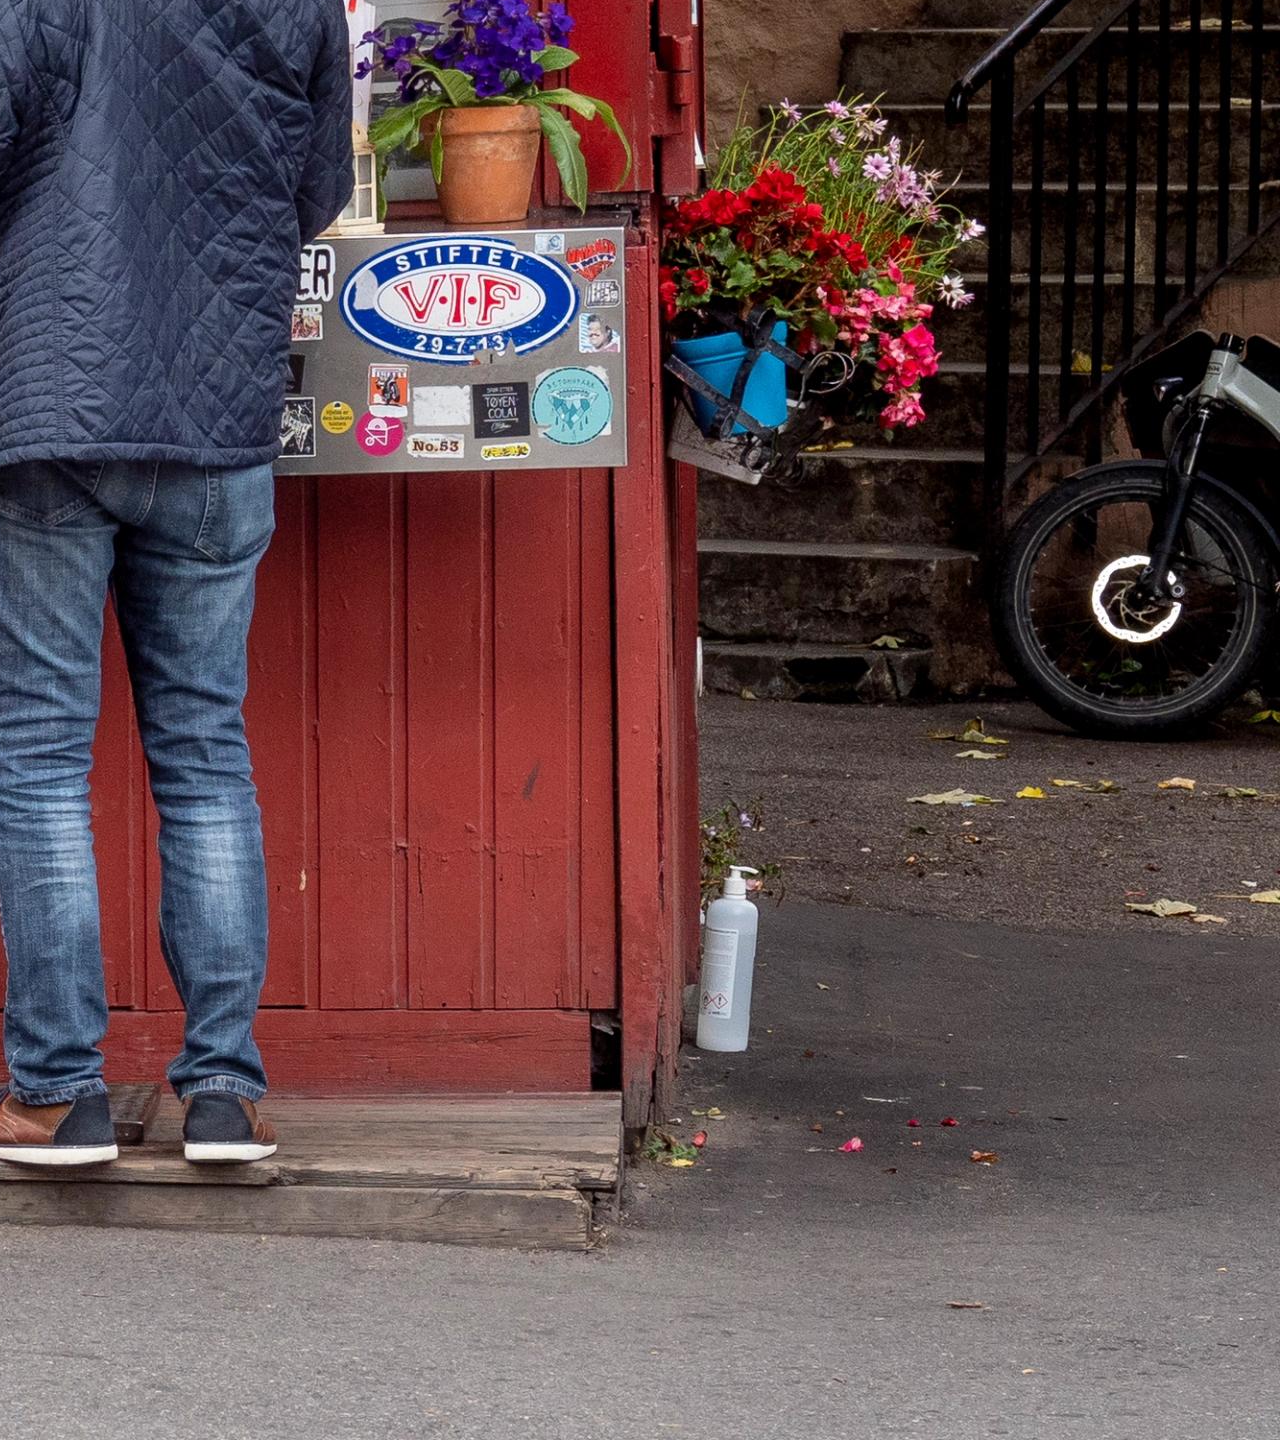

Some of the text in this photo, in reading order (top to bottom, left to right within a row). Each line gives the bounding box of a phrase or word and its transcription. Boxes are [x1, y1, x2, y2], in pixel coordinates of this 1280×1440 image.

[396, 245, 524, 271] STIFTET
[413, 333, 506, 356] 29-7-13
[412, 440, 460, 453] No.53
